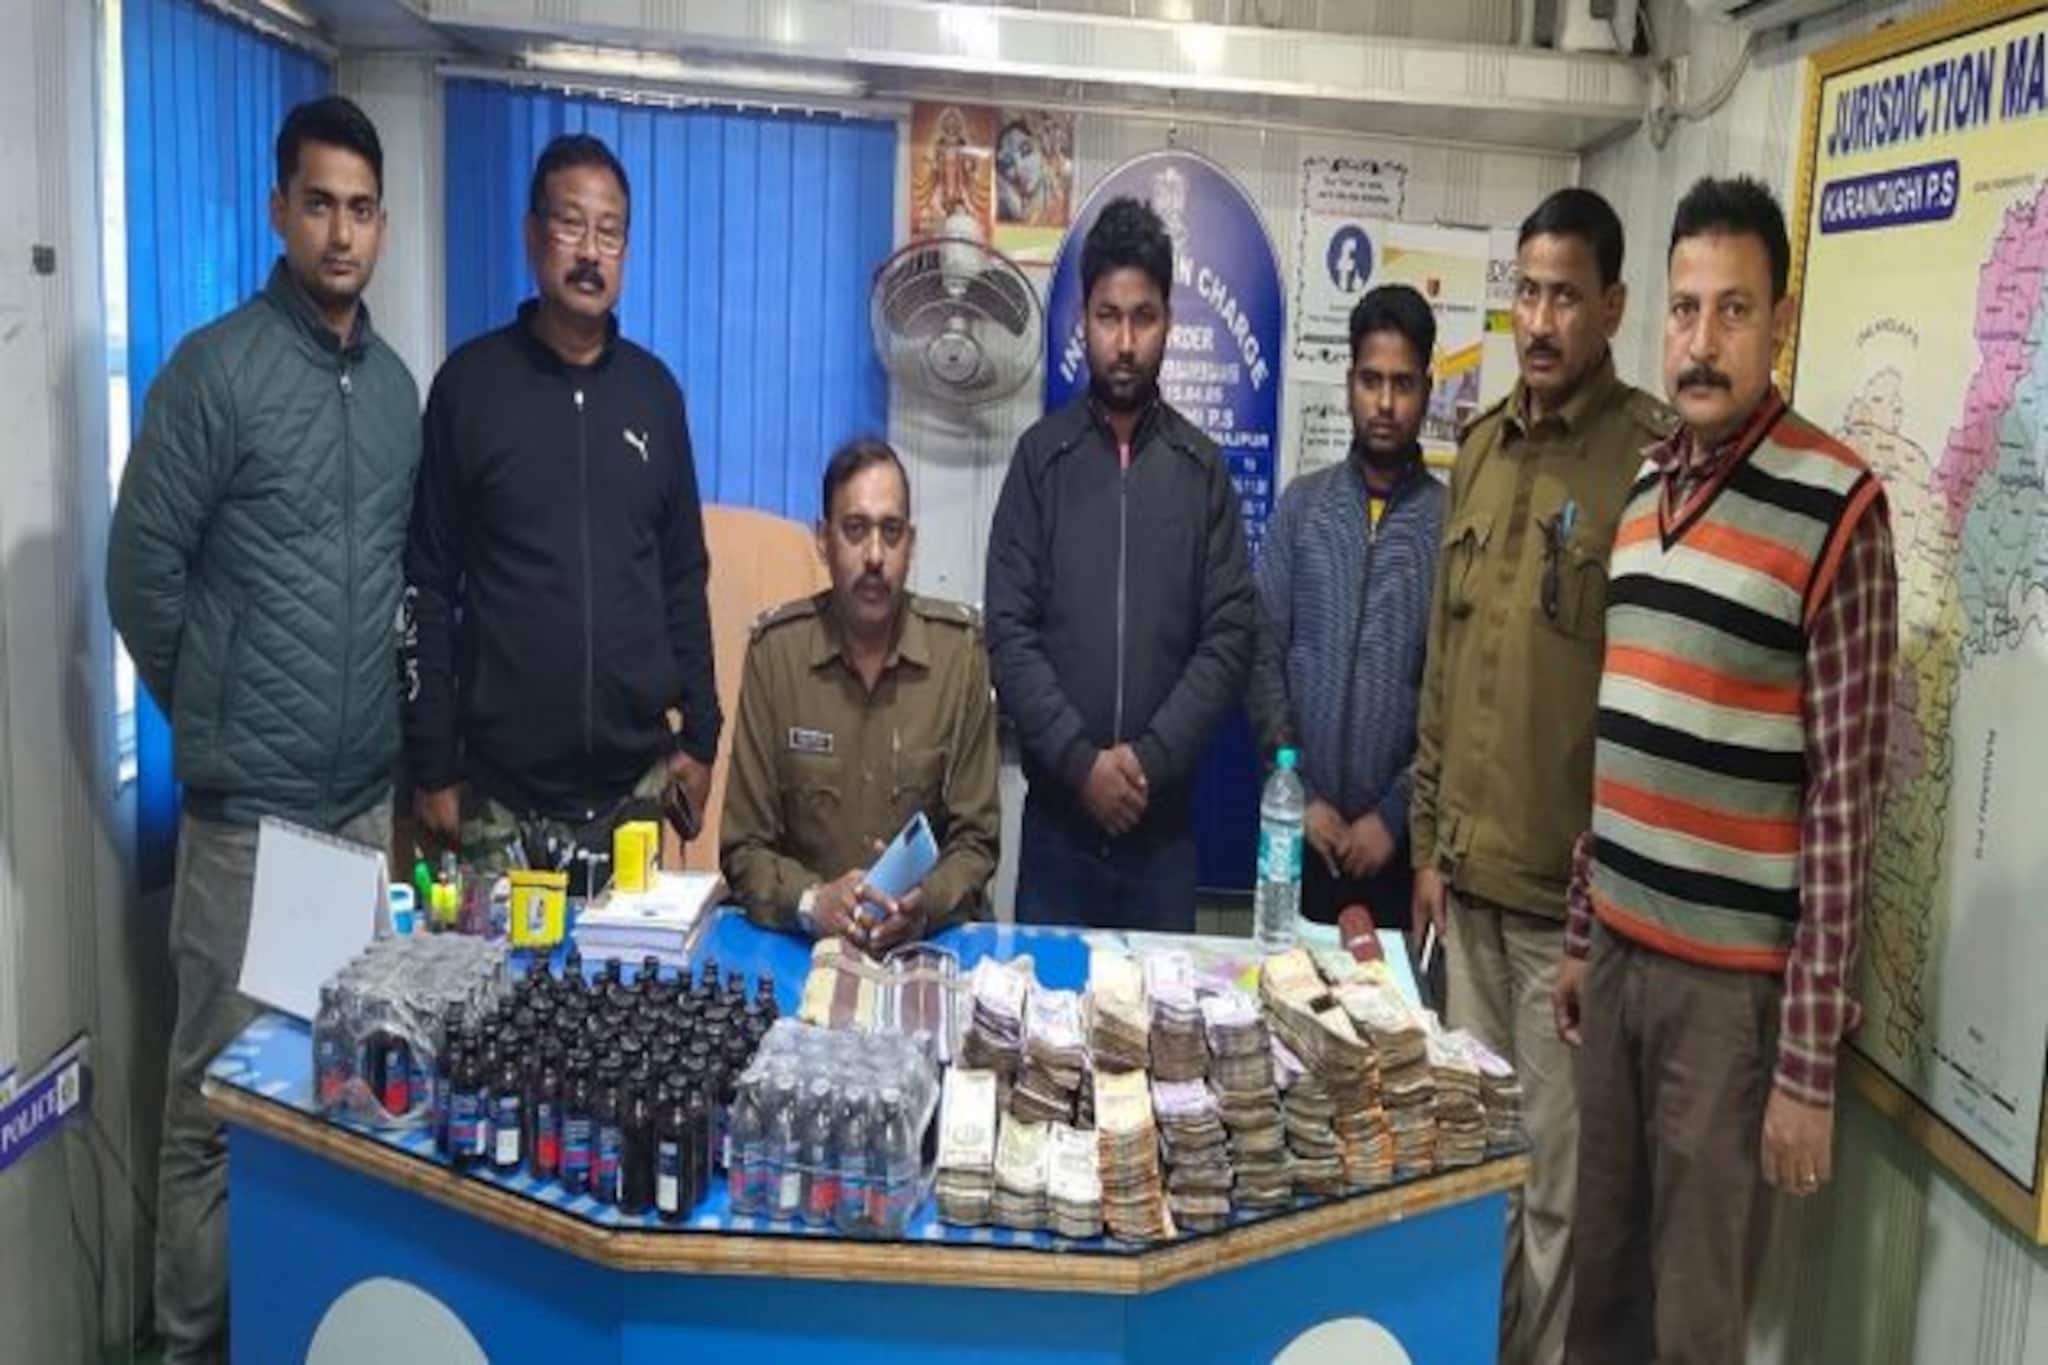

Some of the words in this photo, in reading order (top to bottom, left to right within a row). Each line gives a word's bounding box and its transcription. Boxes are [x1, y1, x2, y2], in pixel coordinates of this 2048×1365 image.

[1828, 46, 1996, 158] JURISDICTION
[1823, 175, 1923, 222] KARANDIGHI
[1198, 267, 1269, 391] CHARGE
